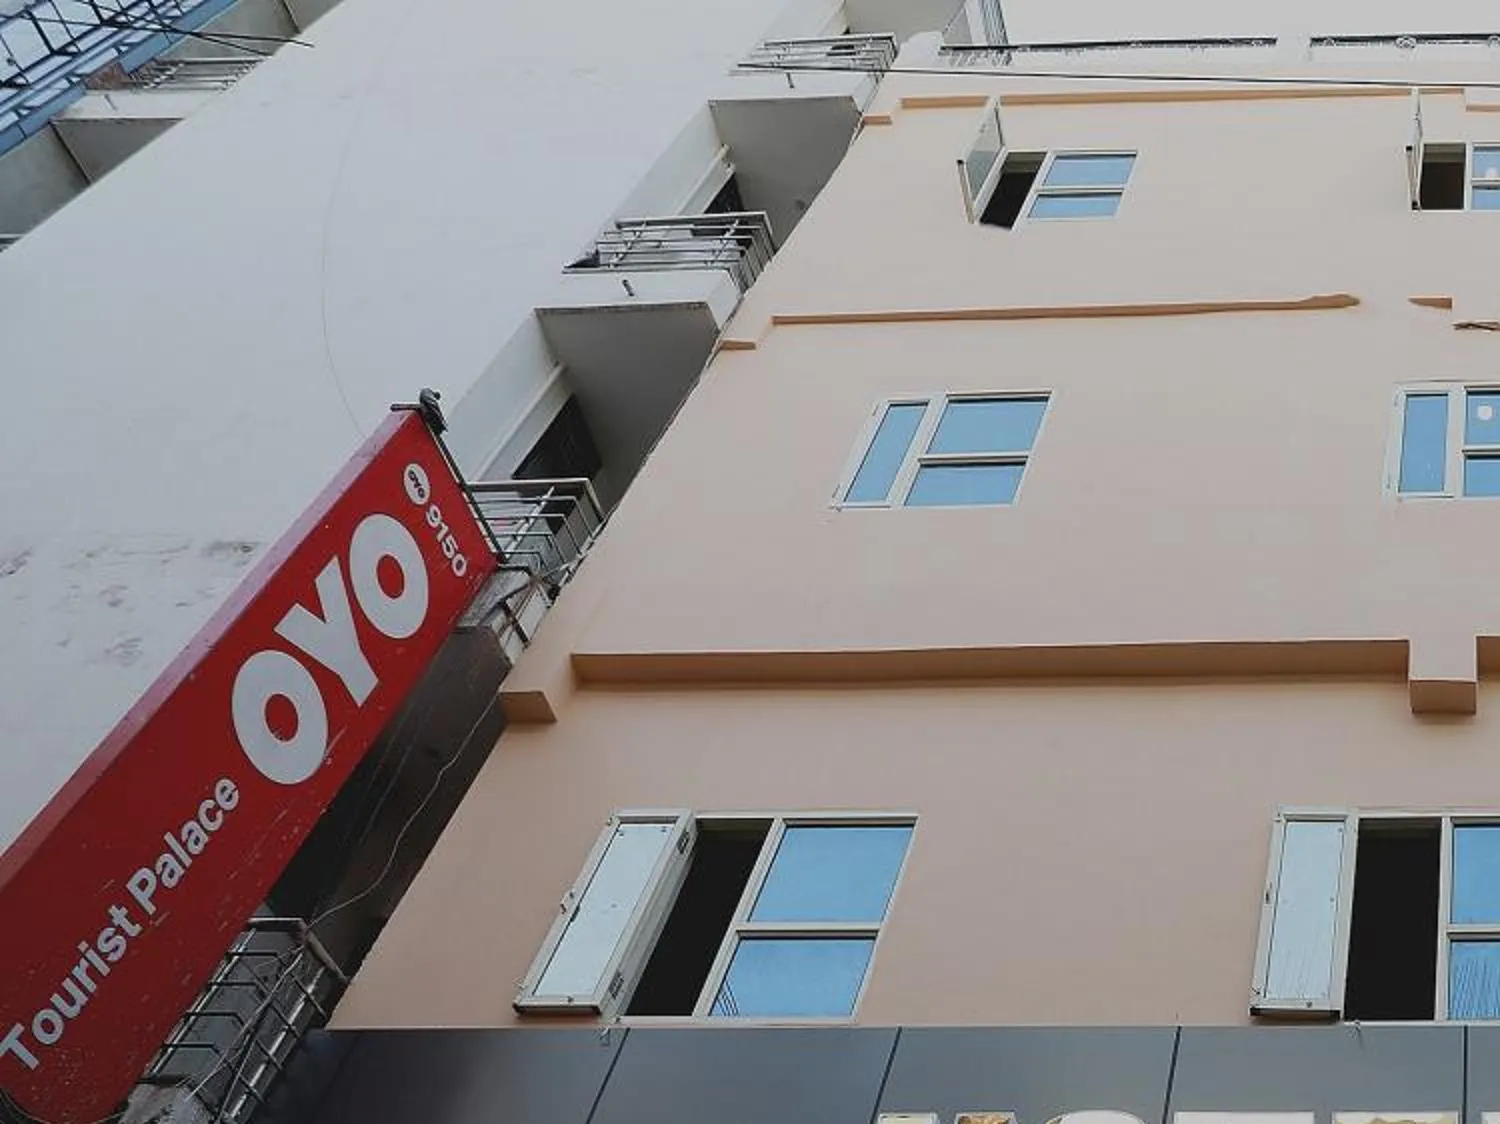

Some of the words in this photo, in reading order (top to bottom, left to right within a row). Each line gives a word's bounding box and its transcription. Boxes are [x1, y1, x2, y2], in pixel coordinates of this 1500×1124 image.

[231, 513, 429, 785] OYO
[426, 504, 467, 577] 9150
[0, 904, 144, 1071] Tourist
[126, 778, 240, 915] Palace
